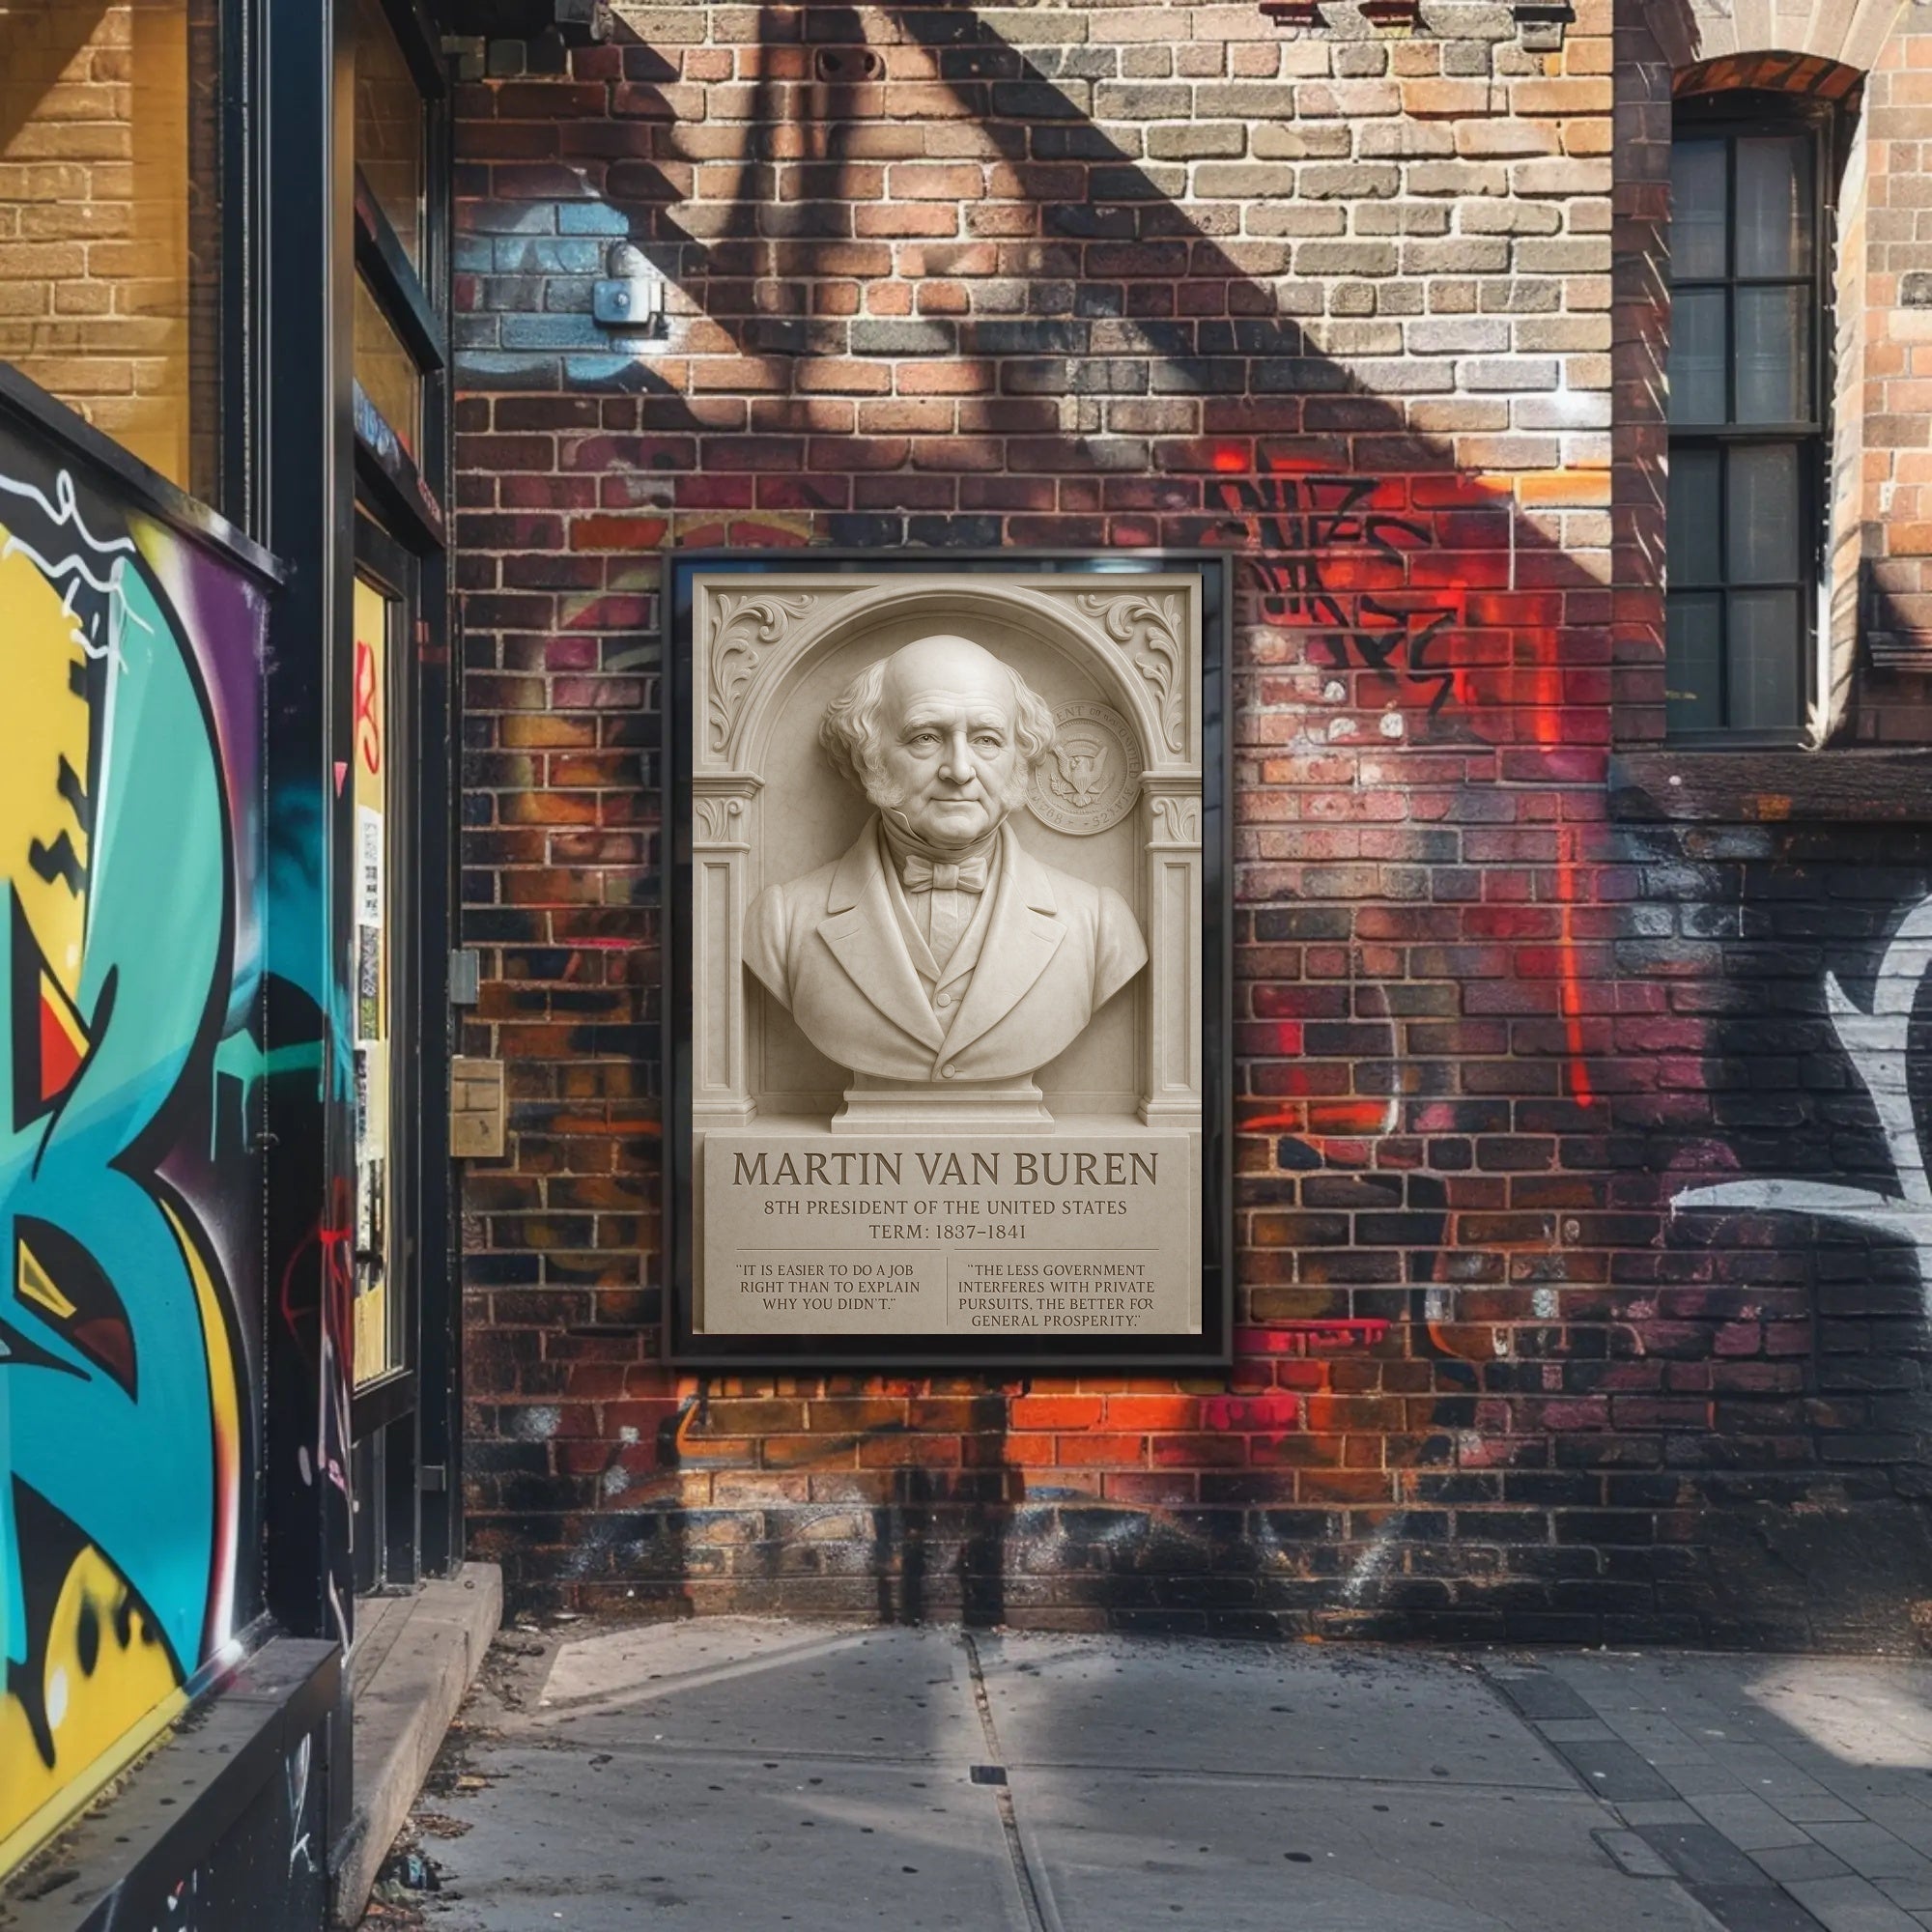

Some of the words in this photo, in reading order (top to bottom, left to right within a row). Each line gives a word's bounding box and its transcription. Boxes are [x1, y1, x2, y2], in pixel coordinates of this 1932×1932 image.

[732, 1152, 902, 1186] MARTIN
[915, 1152, 1000, 1186] VAN
[1013, 1152, 1159, 1186] BUREN
[764, 1200, 800, 1215] 8TH
[806, 1200, 909, 1215] PRESIDENT
[913, 1200, 938, 1215] OF
[942, 1200, 980, 1215] THE
[986, 1200, 1056, 1215] UNITED
[1062, 1200, 1127, 1215] STATES
[868, 1224, 930, 1239] TERM:
[761, 1264, 773, 1276] IS
[778, 1264, 825, 1276] EASIER
[829, 1264, 848, 1276] TO
[852, 1264, 872, 1276] DO
[876, 1264, 886, 1276] A
[887, 1264, 914, 1279] JOB
[1007, 1264, 1039, 1276] LESS
[1042, 1264, 1146, 1276] GOVERNMENT
[740, 1281, 784, 1293] RIGHT
[788, 1281, 830, 1293] THAN
[834, 1281, 854, 1293] TO
[858, 1281, 921, 1293] EXPLAIN
[958, 1281, 1045, 1293] INTERFERES
[1050, 1281, 1090, 1293] WITH
[1094, 1281, 1155, 1293] PRIVATE
[763, 1297, 798, 1310] WHY
[803, 1297, 833, 1310] YOU
[959, 1297, 1033, 1312] PURSUITS,
[1037, 1297, 1065, 1310] THE
[1069, 1297, 1125, 1310] BETTER
[1129, 1297, 1154, 1310] FOR
[972, 1315, 1039, 1327] GENERAL
